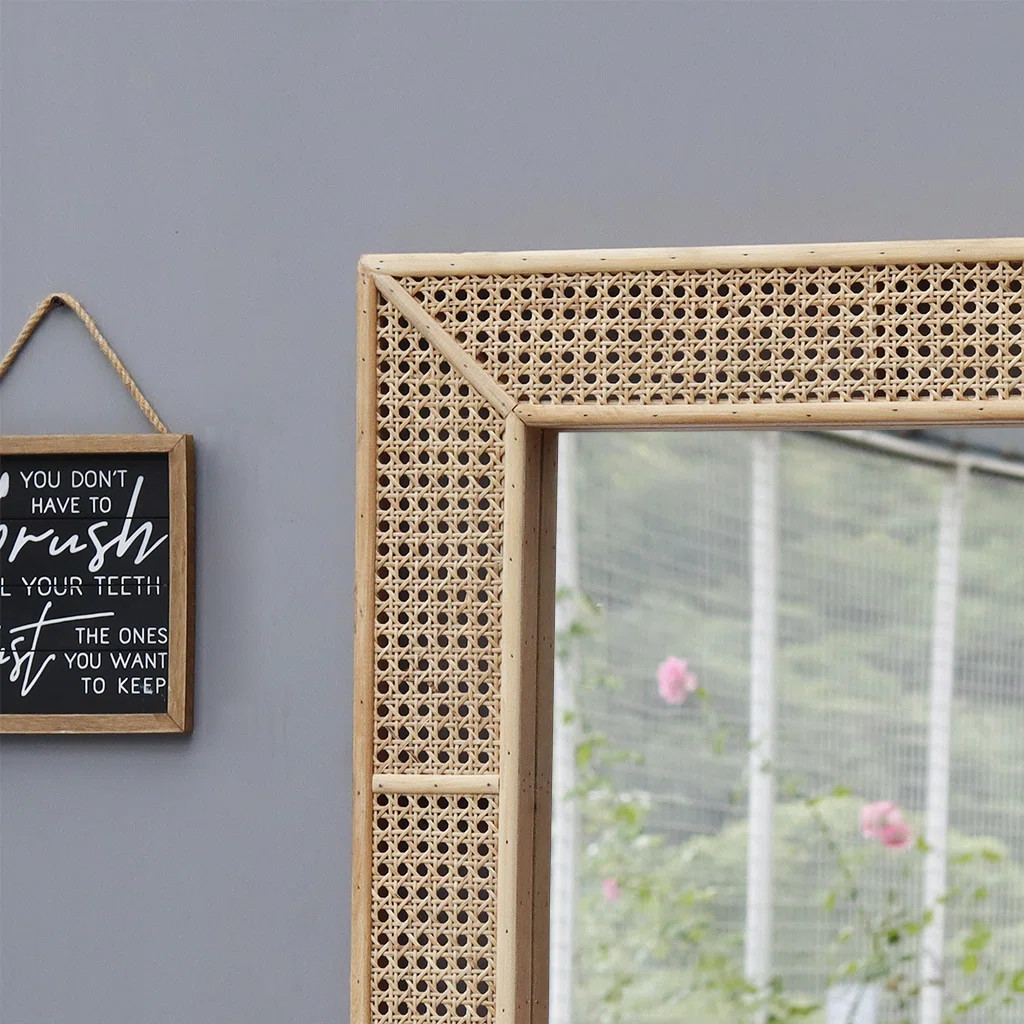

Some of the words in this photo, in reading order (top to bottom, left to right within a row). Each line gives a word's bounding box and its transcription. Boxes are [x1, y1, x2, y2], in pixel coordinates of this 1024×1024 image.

[20, 470, 61, 489] YOU
[71, 469, 128, 488] DON'T
[31, 497, 80, 514] HAVE
[88, 496, 112, 514] TO
[21, 576, 83, 597] YOUR
[93, 575, 160, 596] TEETH
[75, 627, 110, 645] THE
[118, 626, 168, 645] ONES
[63, 652, 102, 670] YOU
[109, 651, 168, 669] WANT
[80, 677, 106, 695] TO
[117, 676, 167, 695] KEEP
